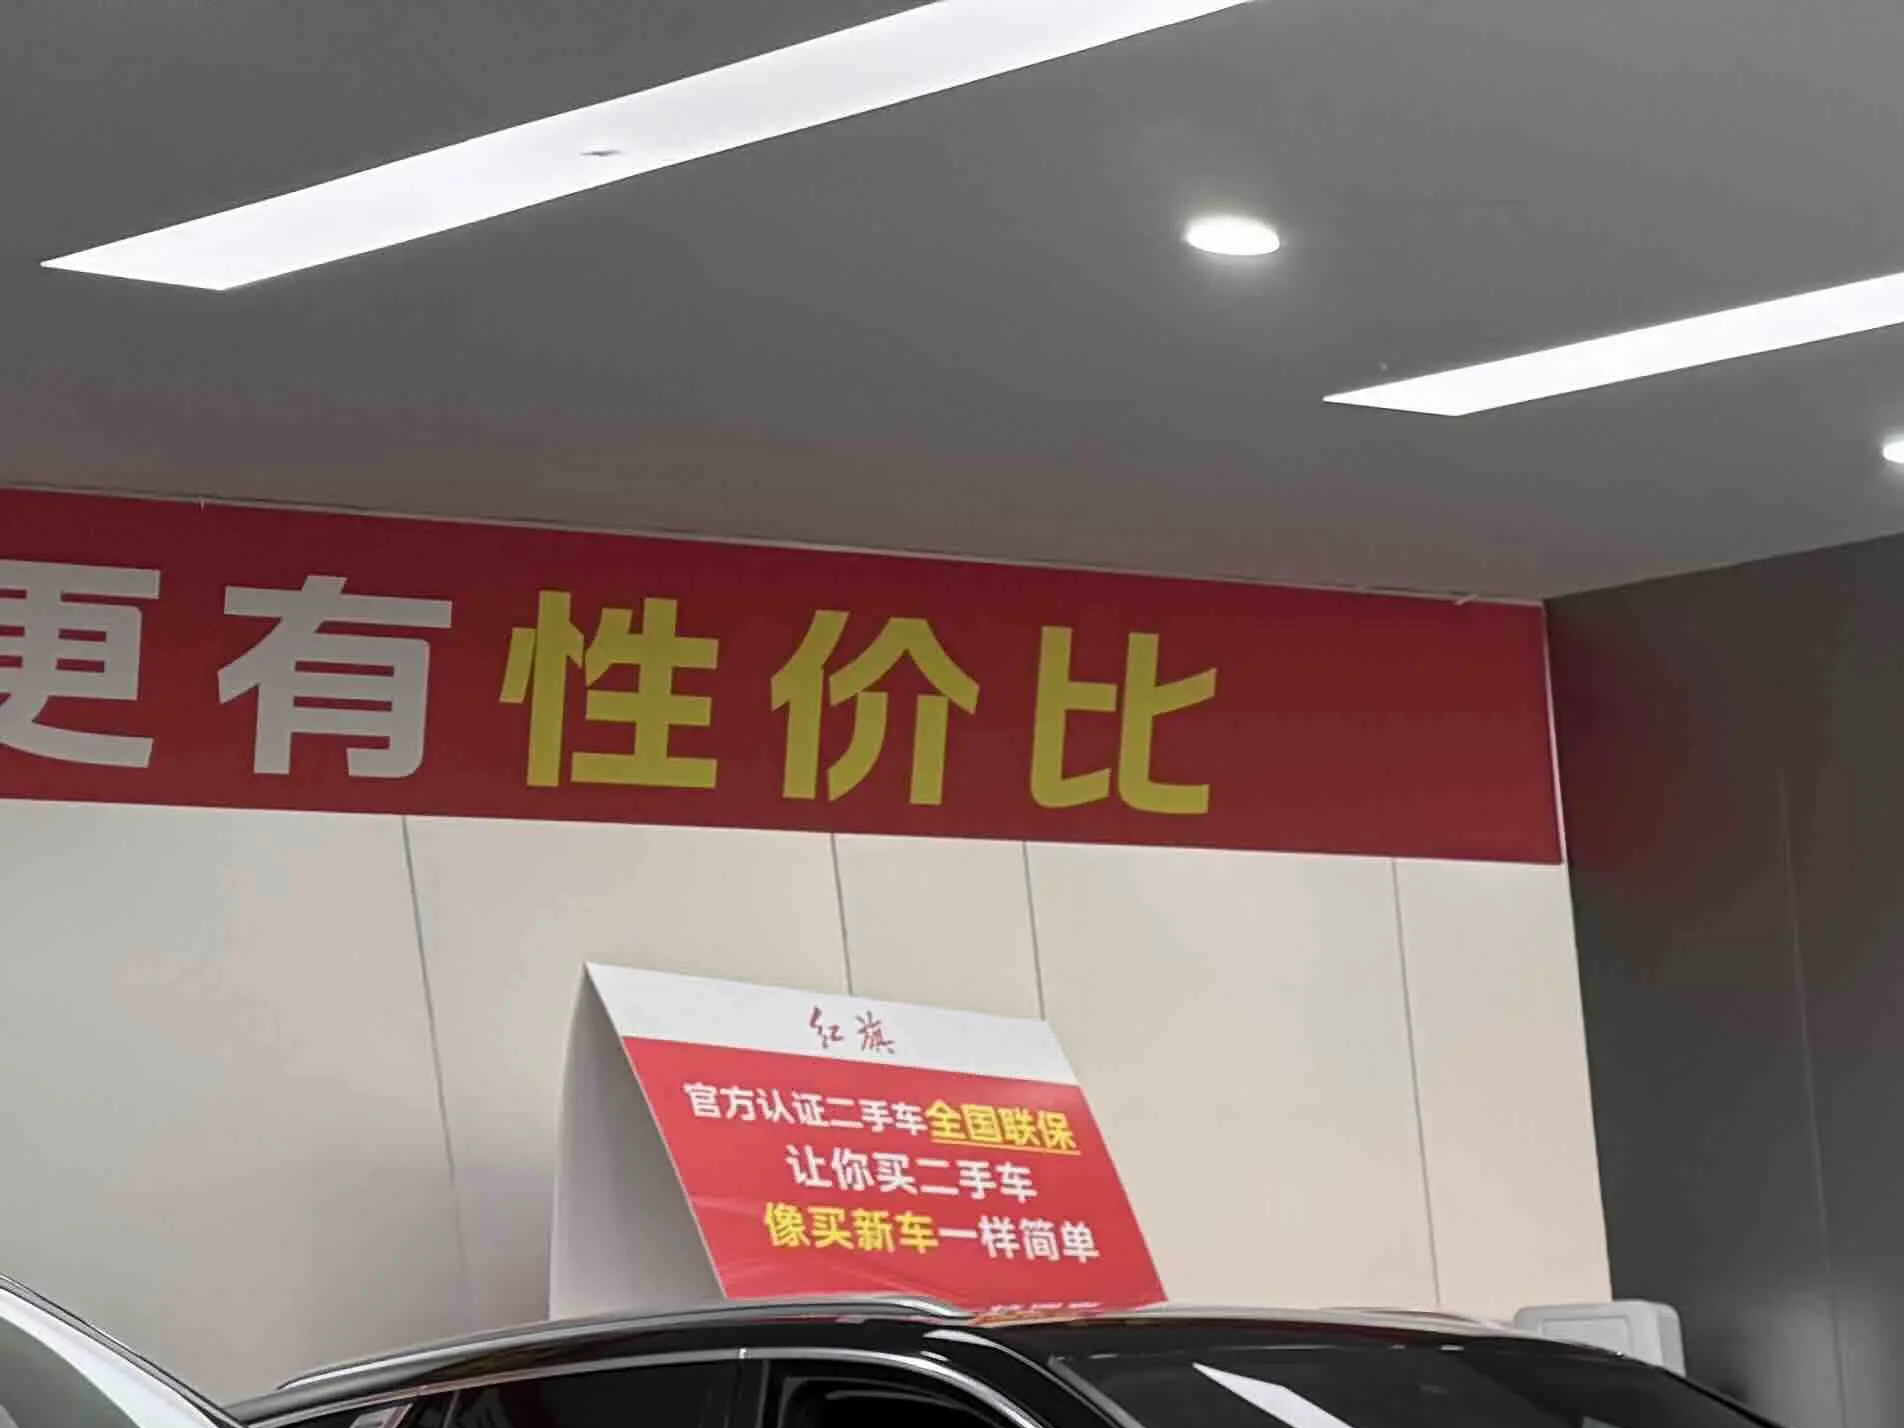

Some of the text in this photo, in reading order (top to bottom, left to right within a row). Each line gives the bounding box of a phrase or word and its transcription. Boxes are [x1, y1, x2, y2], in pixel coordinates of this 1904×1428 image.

[0, 559, 1218, 816] 更有性价比
[809, 1007, 895, 1055] 红旗
[683, 1082, 1079, 1151] 官方认证二手车全国联保
[786, 1145, 1037, 1203] 让你买二手车
[762, 1202, 1100, 1264] 像买新车一样简单
